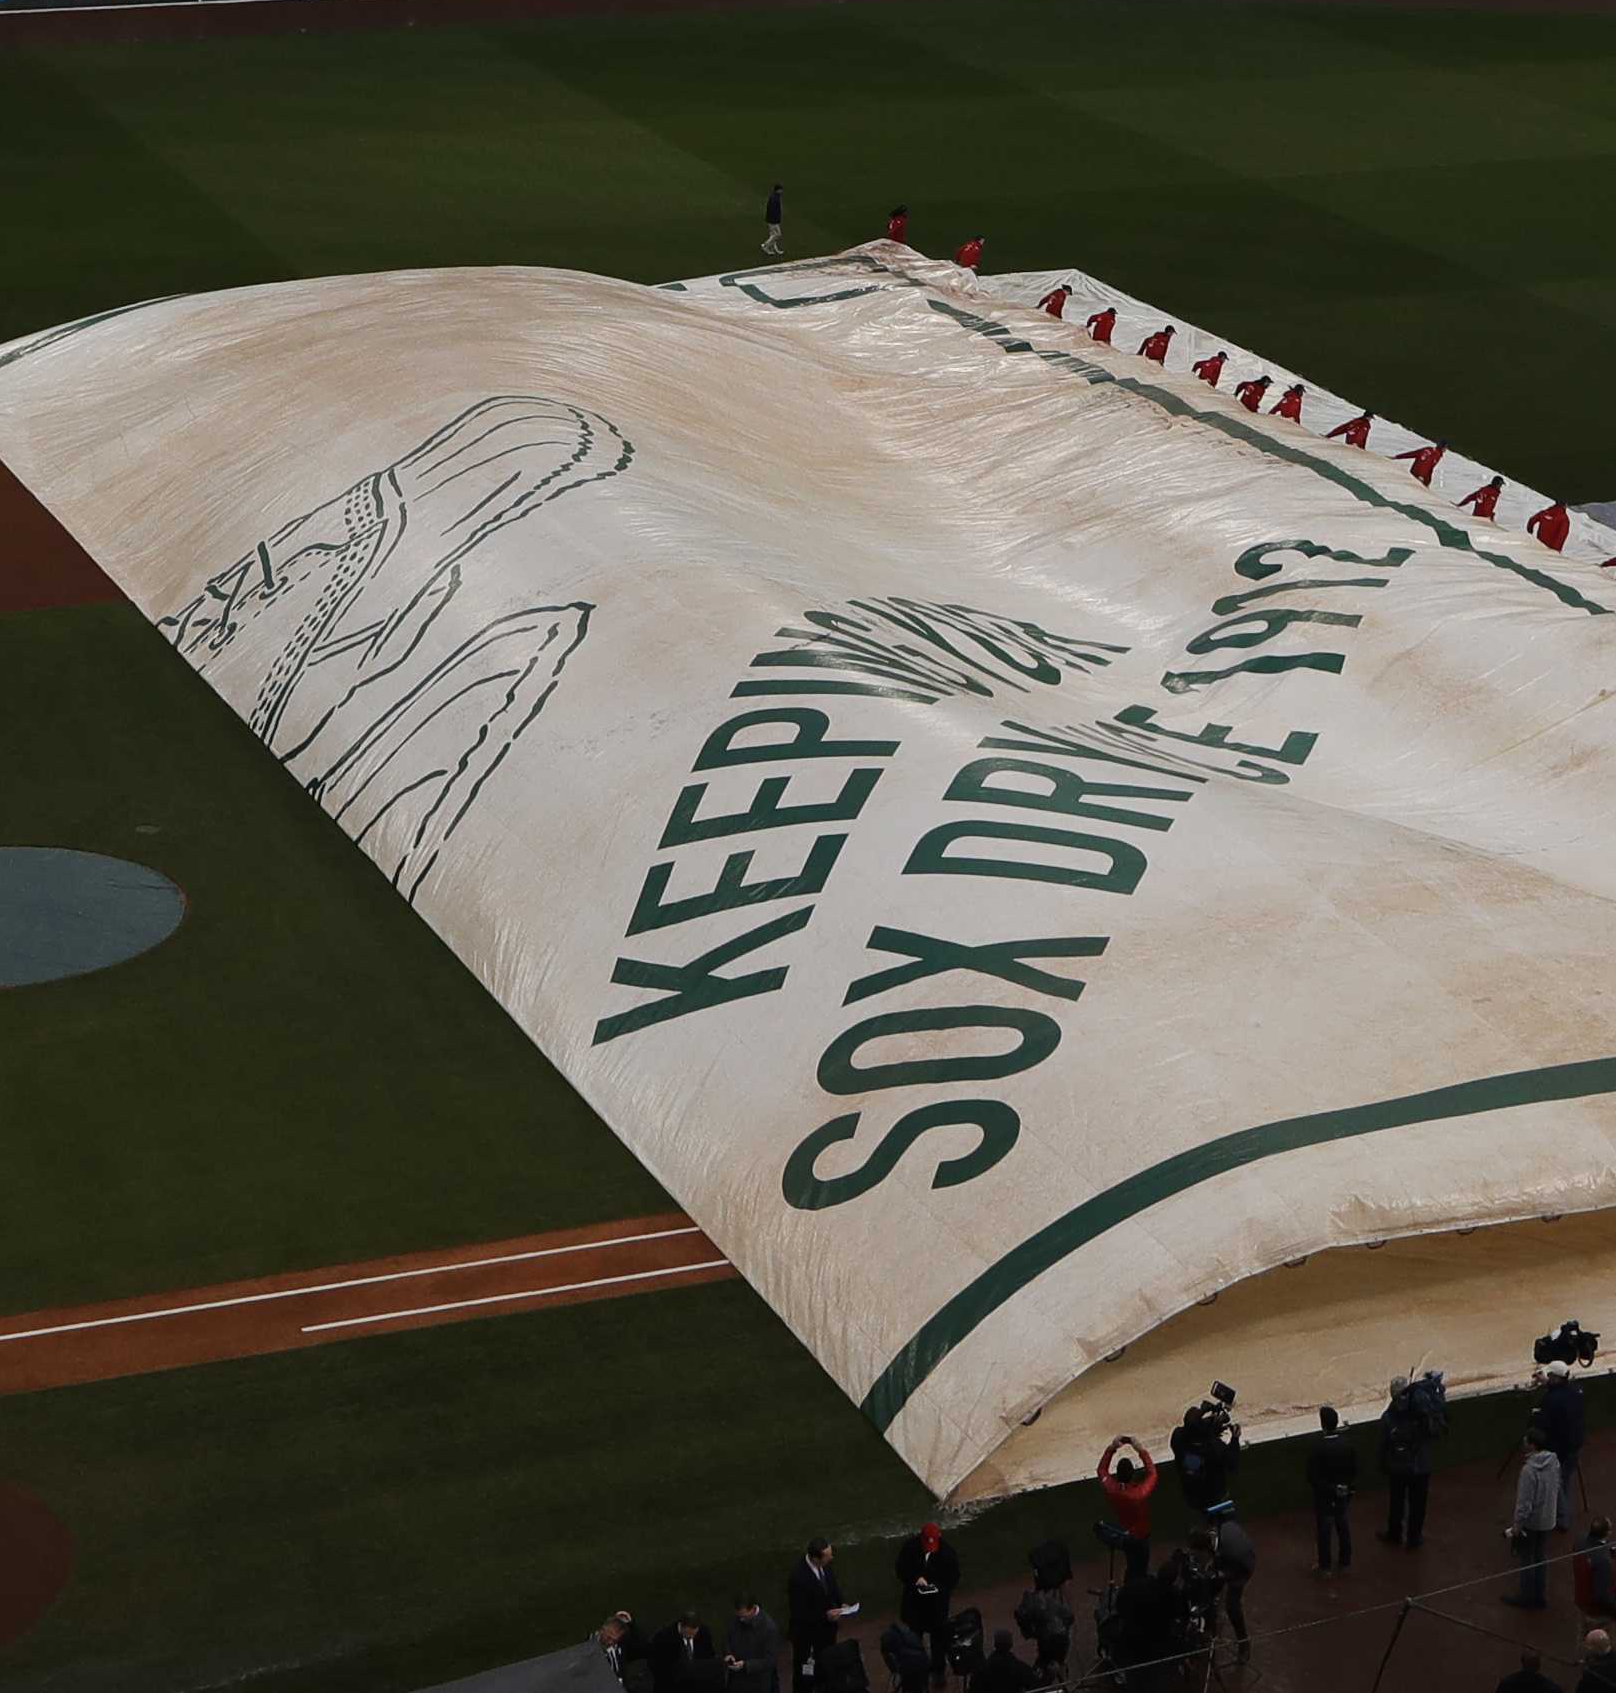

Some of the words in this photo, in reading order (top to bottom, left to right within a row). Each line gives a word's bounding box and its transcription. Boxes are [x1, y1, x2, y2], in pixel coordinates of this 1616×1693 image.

[1162, 539, 1416, 695] 1912
[901, 720, 1209, 896] DRY
[782, 925, 1111, 1212] SOX
